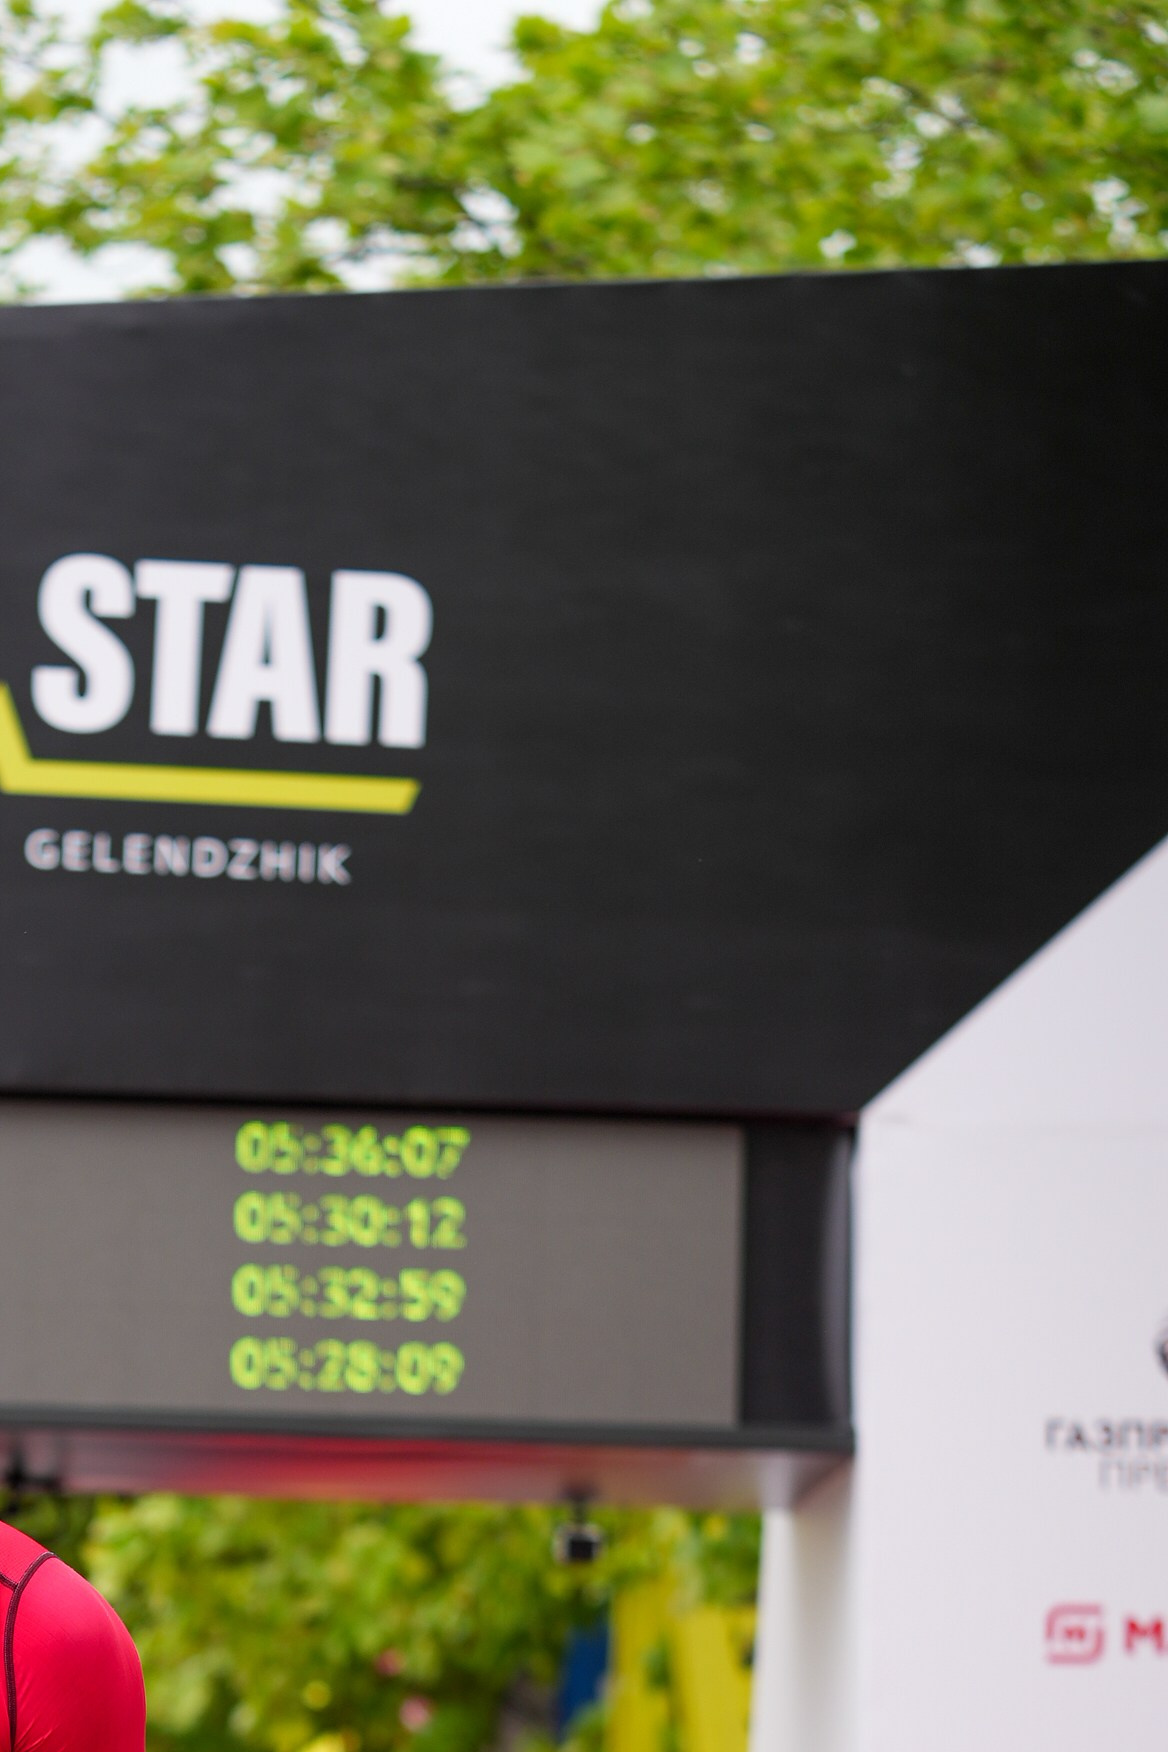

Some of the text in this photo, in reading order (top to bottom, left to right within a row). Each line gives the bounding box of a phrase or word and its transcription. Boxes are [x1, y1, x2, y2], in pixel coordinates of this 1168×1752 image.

[32, 553, 433, 749] STAR
[24, 828, 352, 885] GELENDZHIK
[235, 1119, 472, 1180] 05:36:07
[233, 1189, 469, 1250] 05:30:12
[231, 1262, 467, 1323] 05:32:59
